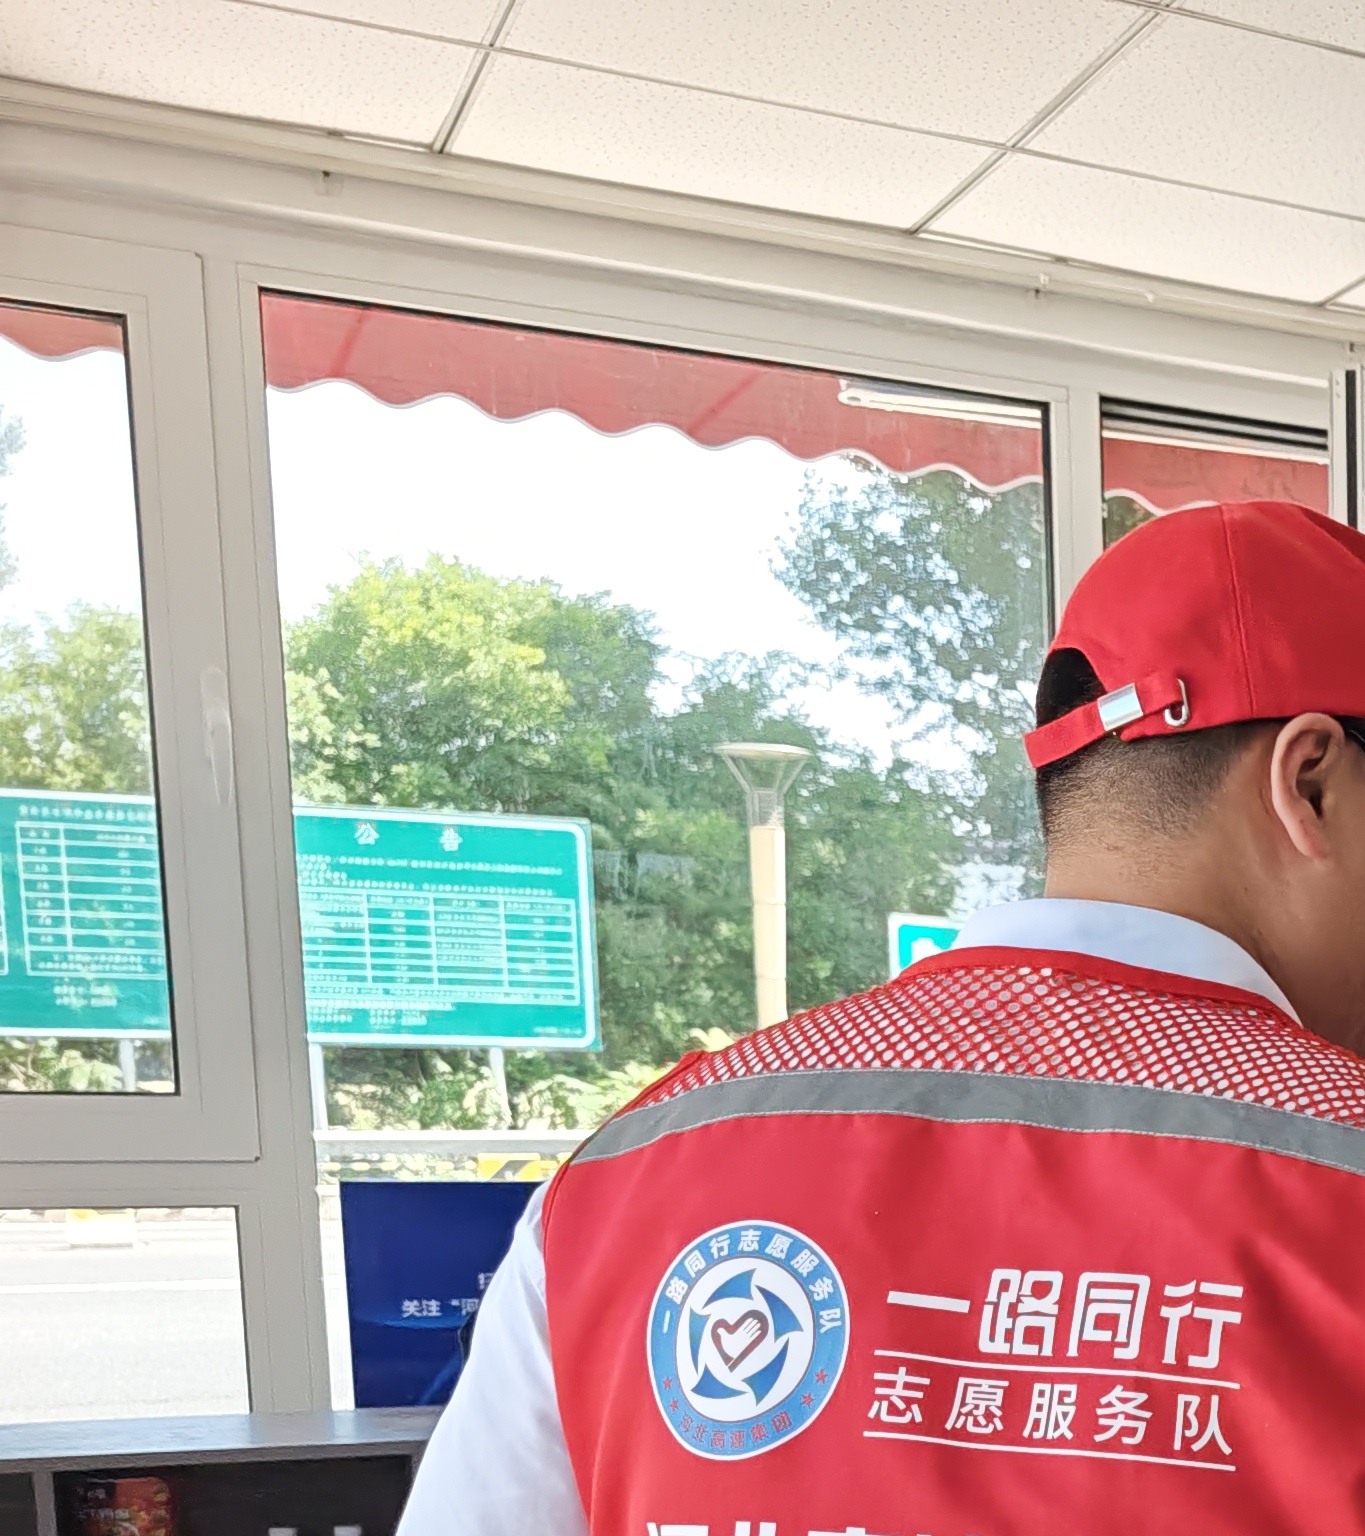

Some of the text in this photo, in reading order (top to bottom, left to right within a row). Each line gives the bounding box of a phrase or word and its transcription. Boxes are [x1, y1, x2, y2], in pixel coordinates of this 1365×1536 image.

[662, 1228, 842, 1335] 一路同行志愿服务队
[886, 1267, 1244, 1370] 一路同行
[867, 1366, 1234, 1456] 志愿服务队
